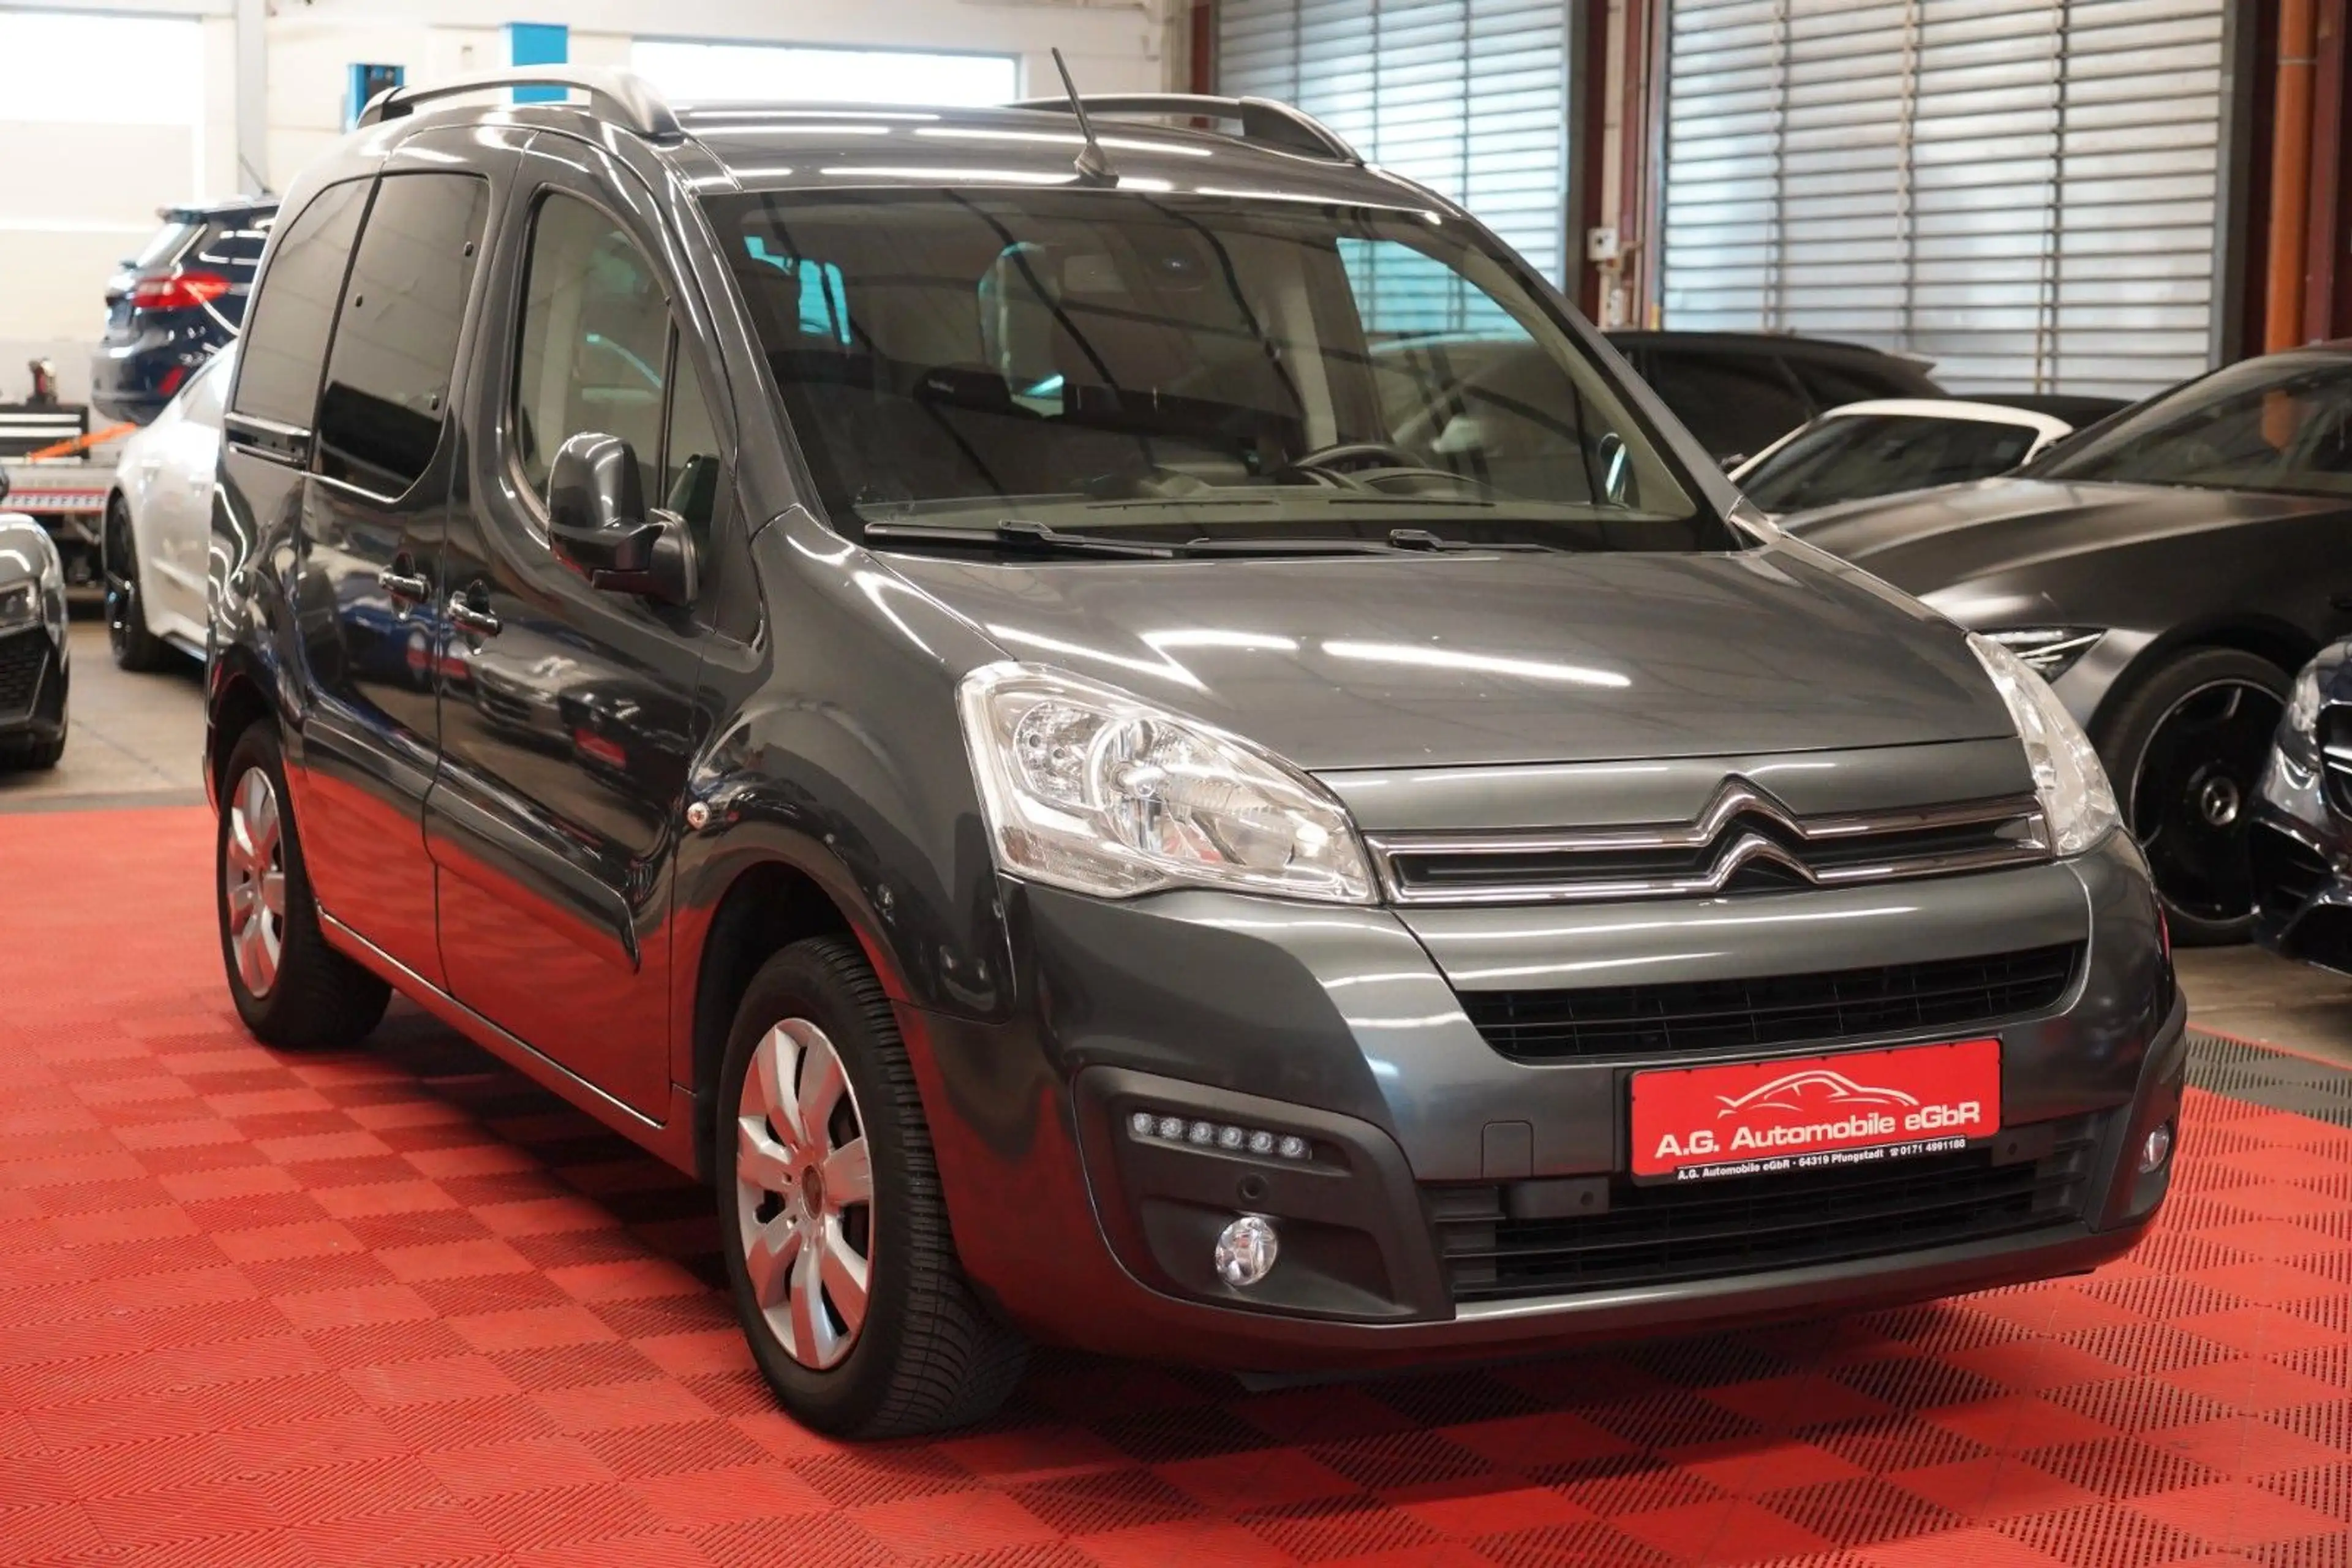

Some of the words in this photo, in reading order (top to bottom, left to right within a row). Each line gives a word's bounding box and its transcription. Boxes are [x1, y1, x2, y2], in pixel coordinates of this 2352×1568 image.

[1654, 1130, 1720, 1158] A.G.
[1730, 1112, 1895, 1150] Automobile
[1905, 1101, 1980, 1131] eGbR
[1677, 1169, 1700, 1180] A.G.
[1702, 1162, 1760, 1177] Automobile
[1763, 1159, 1790, 1171] eGbR
[1798, 1155, 1830, 1167] 64319
[1831, 1149, 1884, 1164] Pfungstadt
